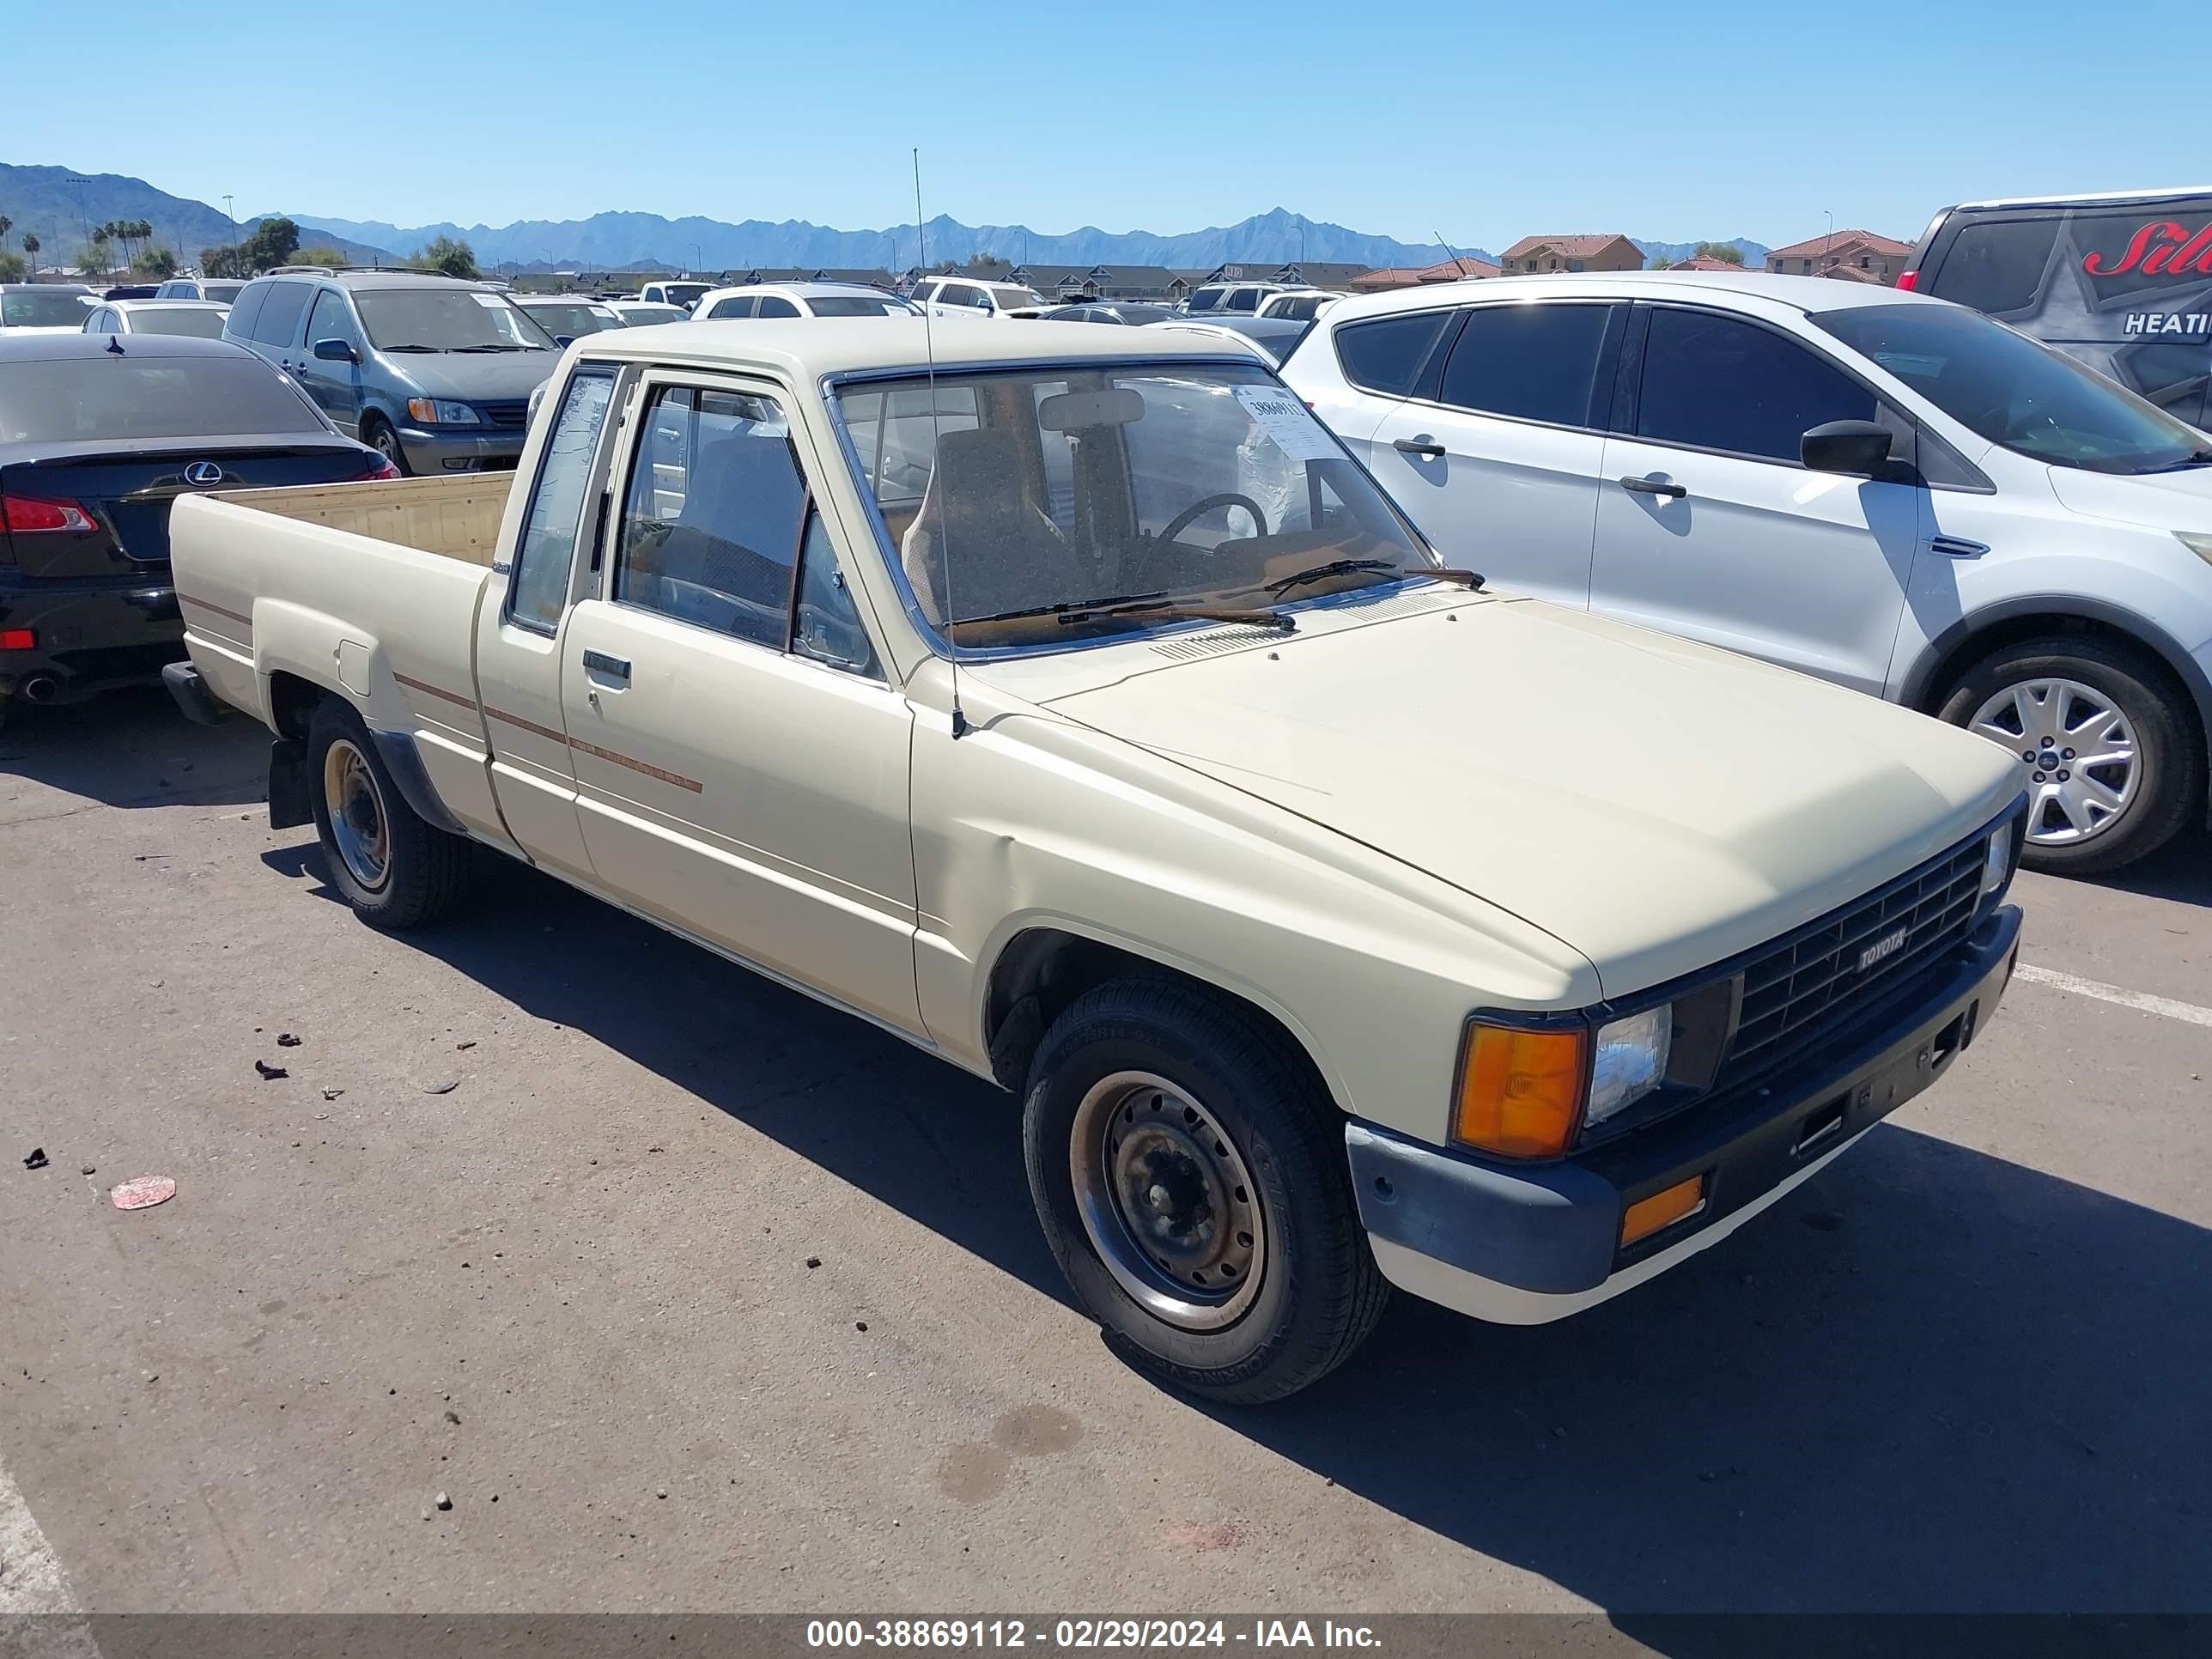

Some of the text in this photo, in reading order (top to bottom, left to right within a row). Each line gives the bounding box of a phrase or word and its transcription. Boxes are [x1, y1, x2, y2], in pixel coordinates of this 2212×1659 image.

[2124, 313, 2212, 333] HEATI
[1249, 401, 1305, 416] 38869112
[1862, 931, 1904, 969] TOYOTA
